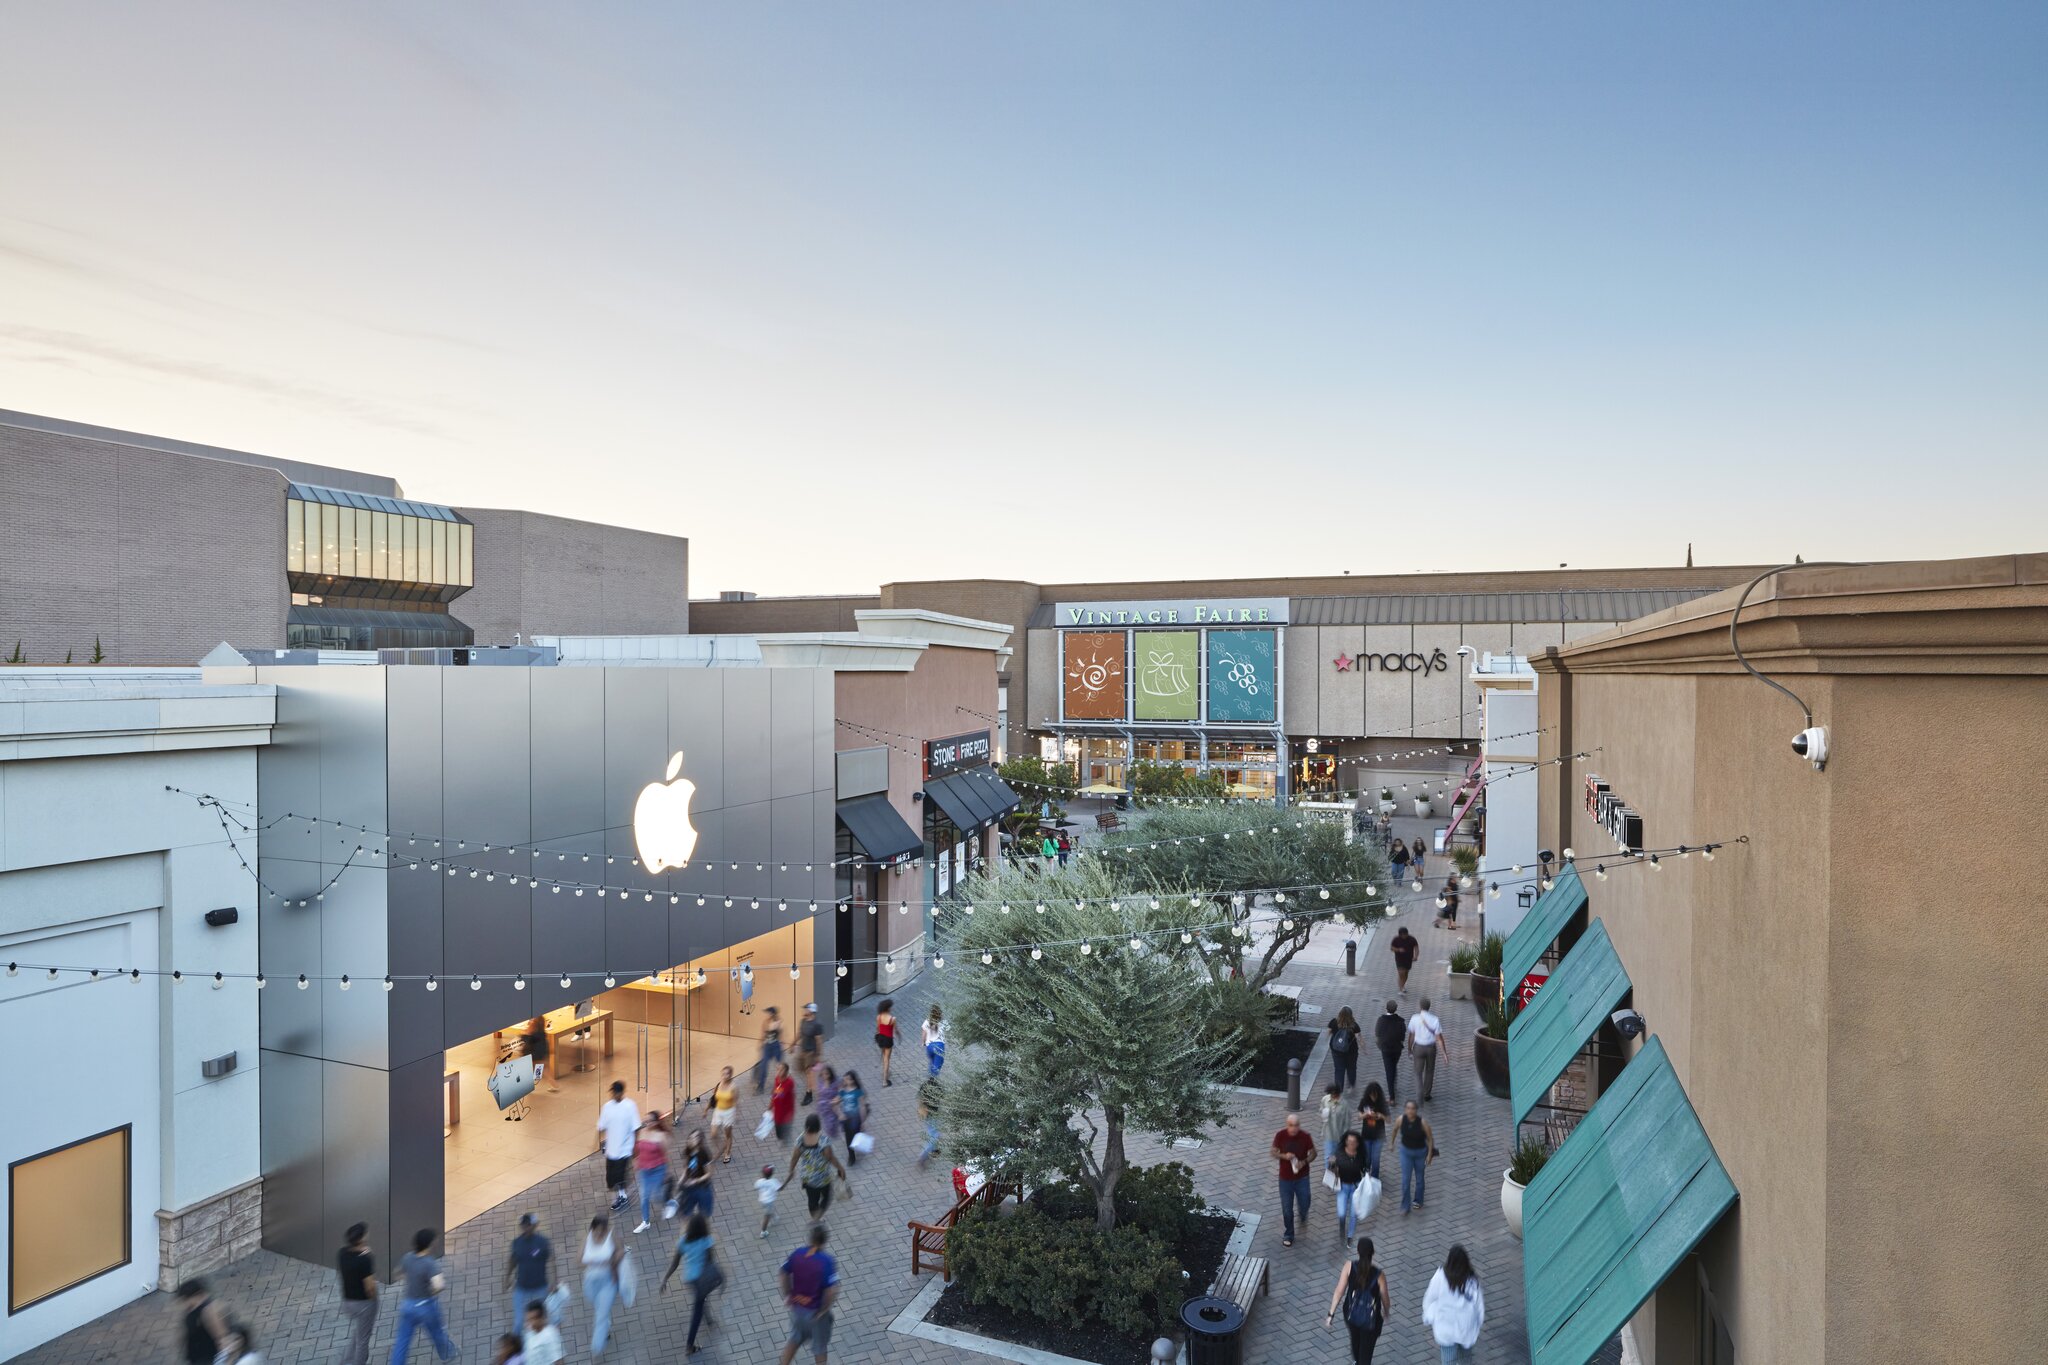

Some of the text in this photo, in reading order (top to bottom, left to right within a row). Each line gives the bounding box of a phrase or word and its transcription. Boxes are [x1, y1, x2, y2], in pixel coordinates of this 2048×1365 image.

[1068, 605, 1270, 624] VINTAGE FAIRE
[933, 738, 989, 766] STONE FIRE PIZZA
